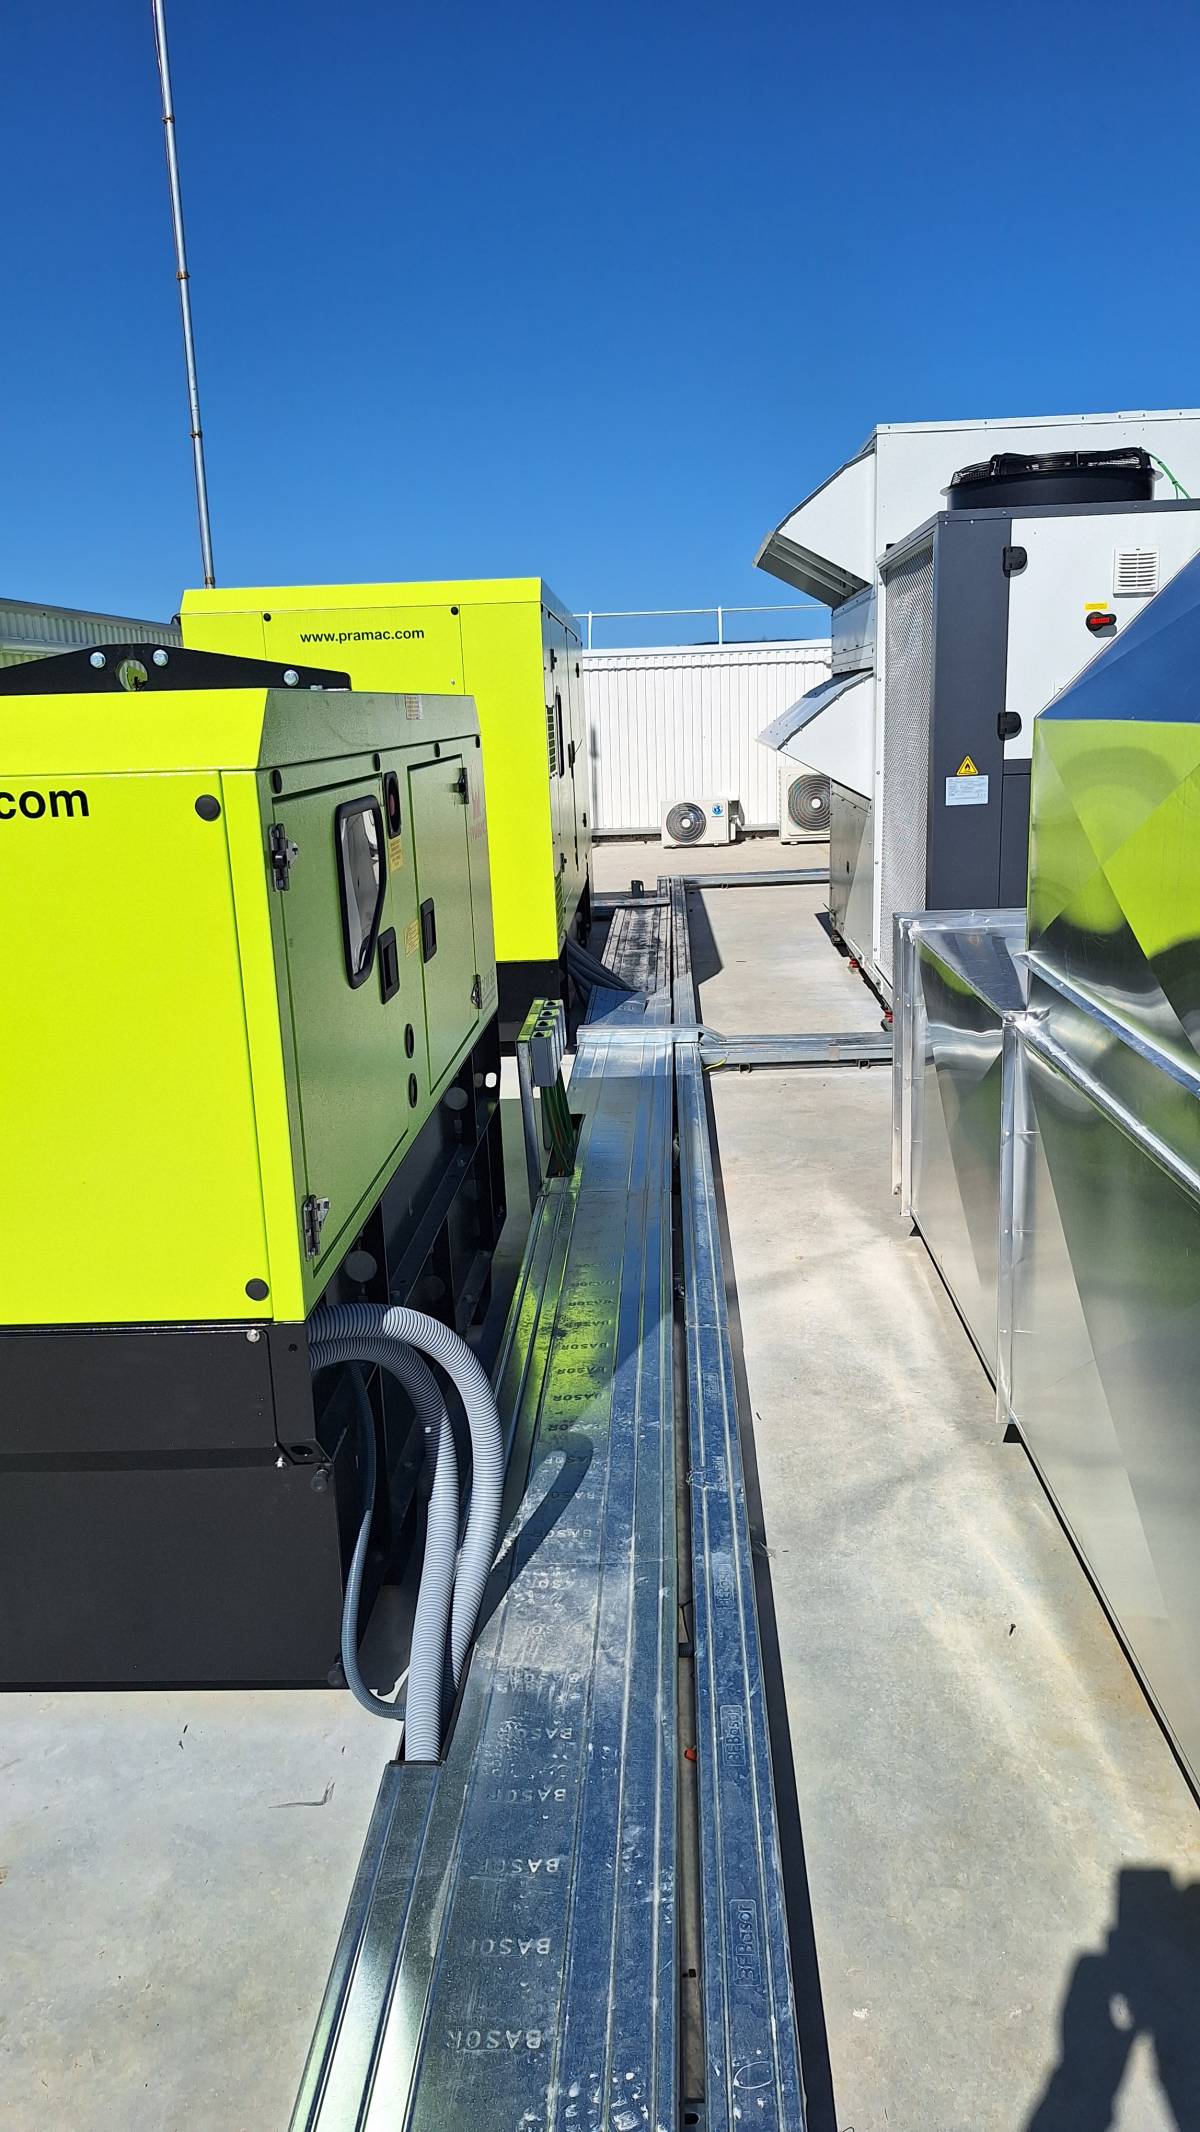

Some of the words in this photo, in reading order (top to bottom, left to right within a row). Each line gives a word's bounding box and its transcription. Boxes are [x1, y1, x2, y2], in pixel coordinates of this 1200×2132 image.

[300, 629, 424, 644] www.pramac.com
[0, 790, 89, 819] com
[446, 2029, 542, 2050] BASOR
